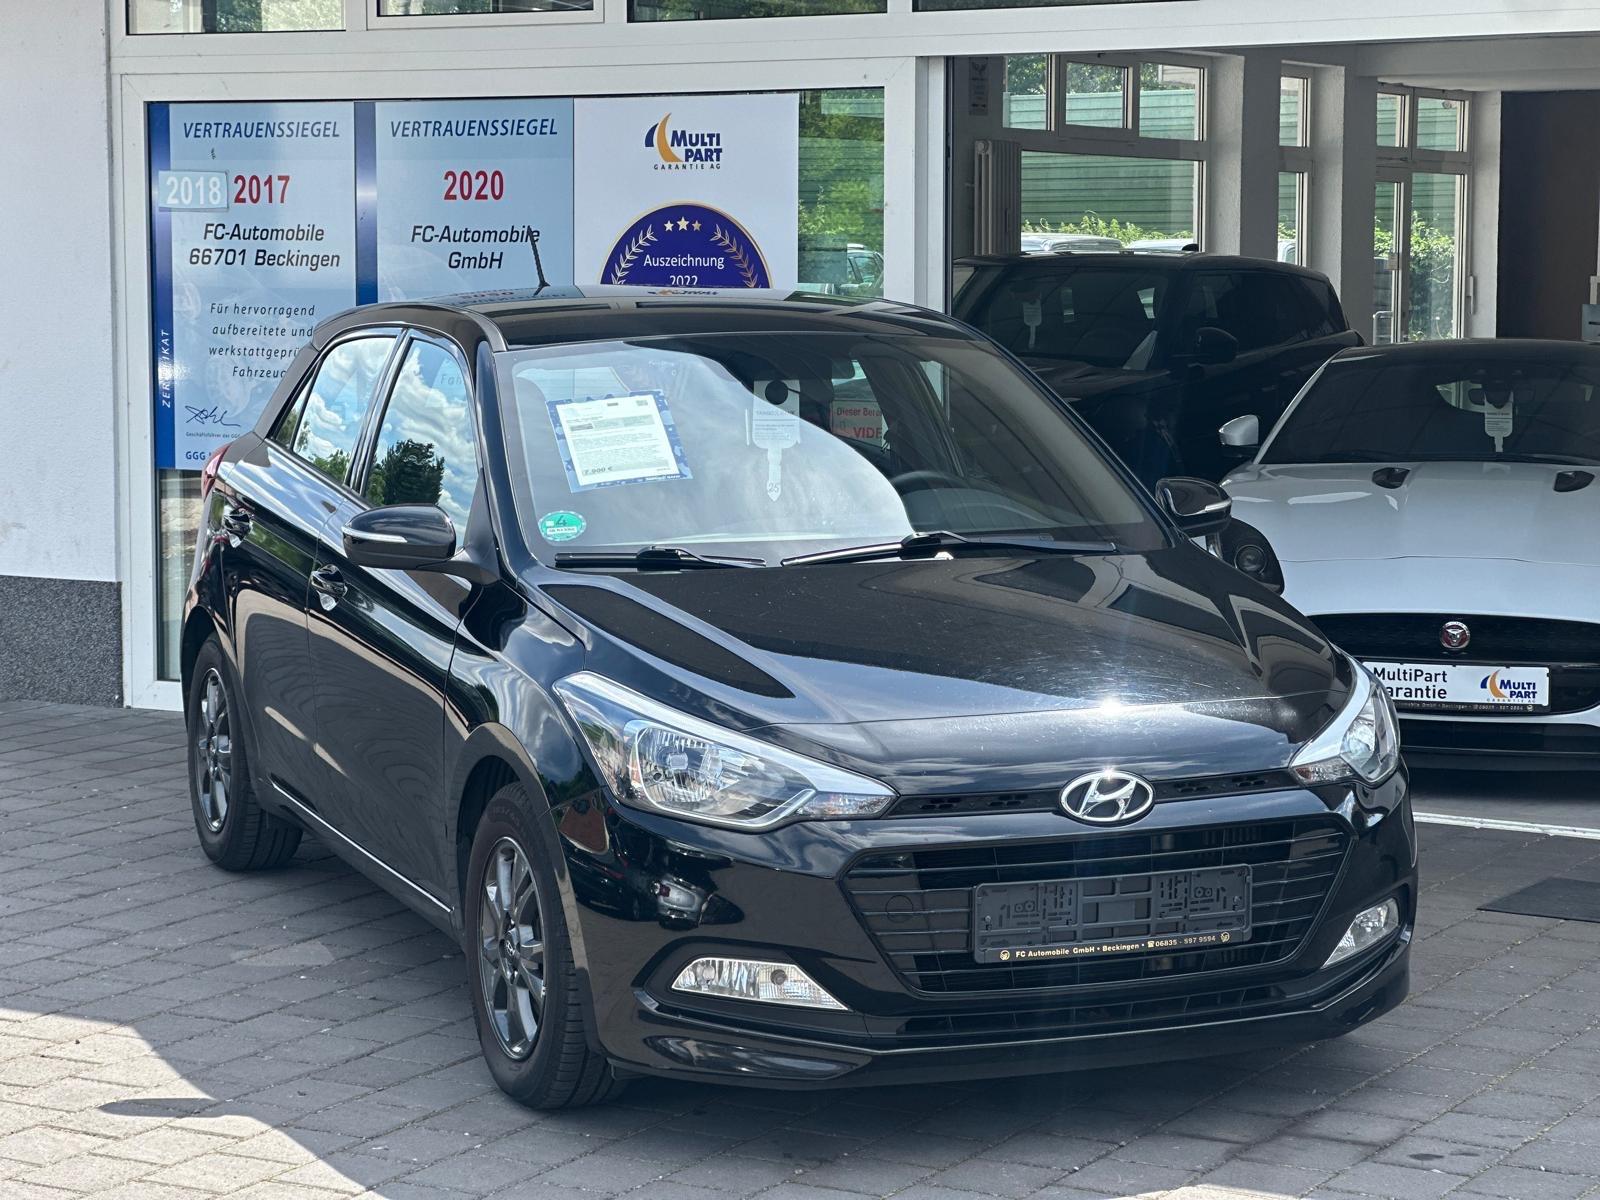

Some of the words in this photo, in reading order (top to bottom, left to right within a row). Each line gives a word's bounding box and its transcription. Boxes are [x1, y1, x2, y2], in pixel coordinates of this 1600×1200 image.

[183, 121, 340, 138] VERTRAUENSSIEGEL
[390, 118, 558, 138] VERTRAUENSSIEGEL
[670, 130, 721, 147] MULTI
[684, 148, 723, 162] PART
[166, 176, 221, 205] 2018
[233, 174, 291, 204] 2017
[443, 170, 504, 201] 2020
[203, 223, 325, 241] FC-Automobile
[411, 225, 540, 243] FC-Automobile
[189, 248, 247, 266] 66701
[254, 249, 341, 271] Beckingen
[448, 251, 504, 269] GmbH
[643, 253, 725, 270] Auszeichnung
[669, 275, 698, 286] 2022
[210, 303, 229, 314] Für
[233, 304, 316, 318] hervorragend
[212, 324, 286, 337] aufbereitete
[291, 326, 314, 337] und
[161, 329, 171, 408] ZERFIKAT
[185, 450, 206, 460] GGG
[1373, 667, 1447, 682] MultiPart
[1386, 685, 1447, 699] arantie
[1499, 679, 1536, 690] MULTI
[1509, 690, 1537, 698] PART
[1015, 950, 1026, 958] FC
[1028, 949, 1070, 957] Automobile
[1072, 946, 1095, 954] GmbH
[1102, 943, 1139, 952] Beckingen
